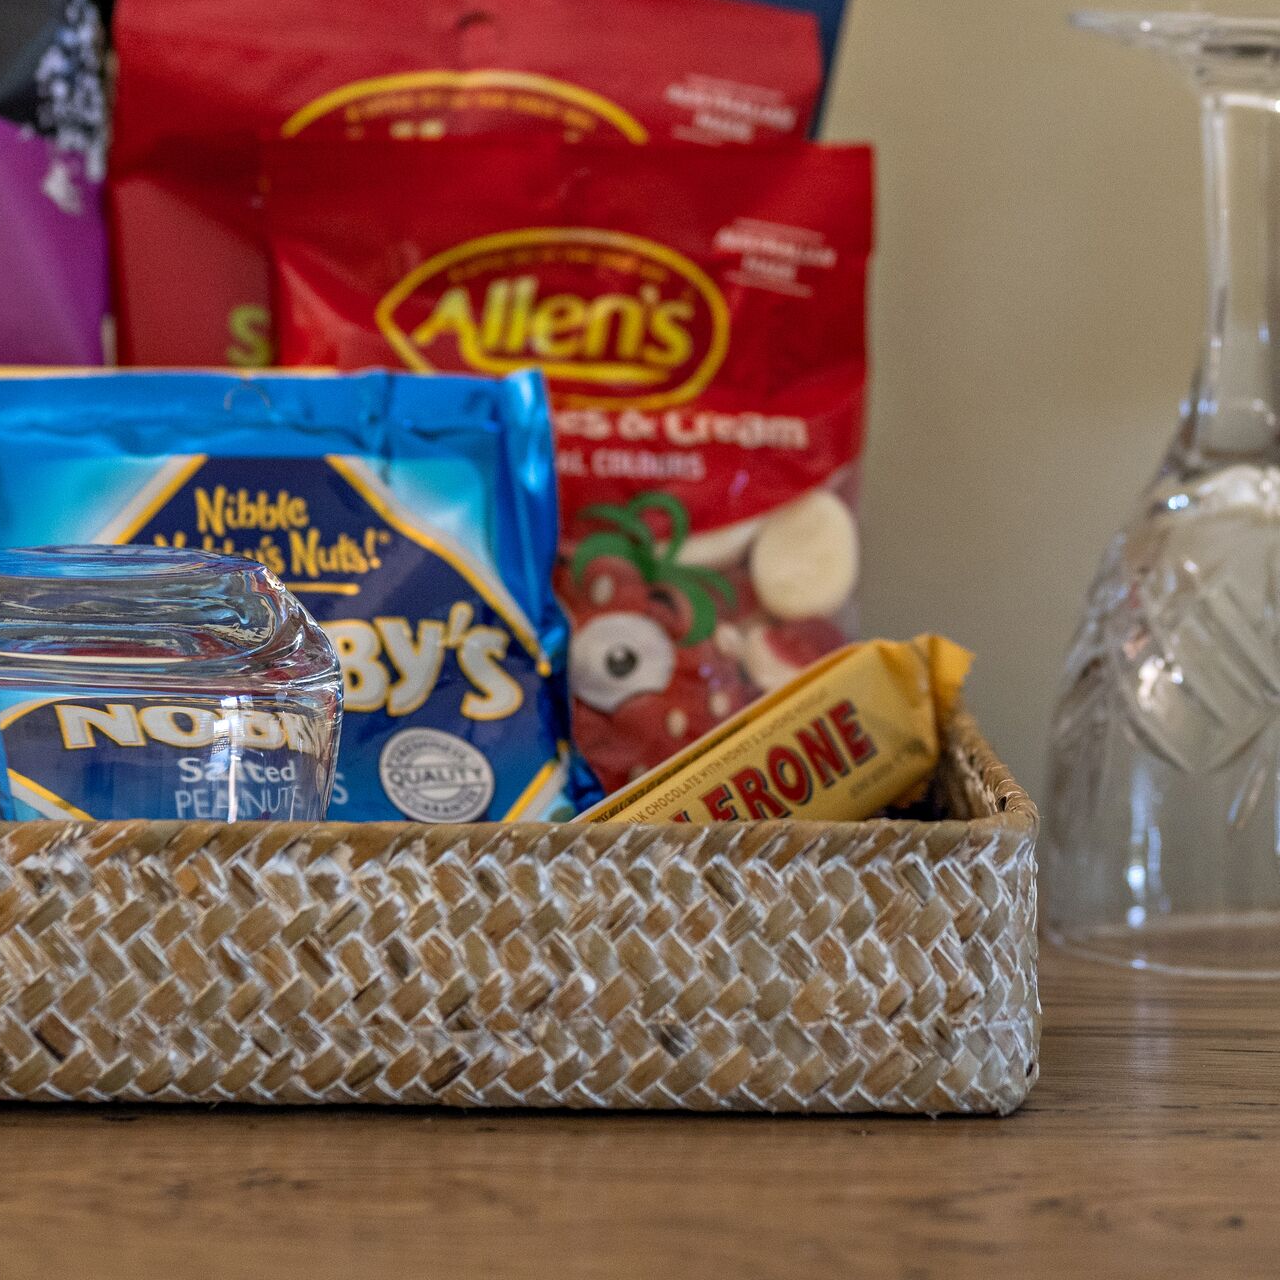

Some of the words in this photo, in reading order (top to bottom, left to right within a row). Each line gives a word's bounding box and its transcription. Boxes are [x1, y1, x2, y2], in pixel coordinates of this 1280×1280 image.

[413, 275, 695, 380] Allen's
[664, 410, 807, 450] Cream
[195, 486, 309, 537] Nibble
[288, 528, 382, 577] Nuts!
[388, 765, 483, 788] QUALITY
[644, 773, 704, 817] CHOCOLATE
